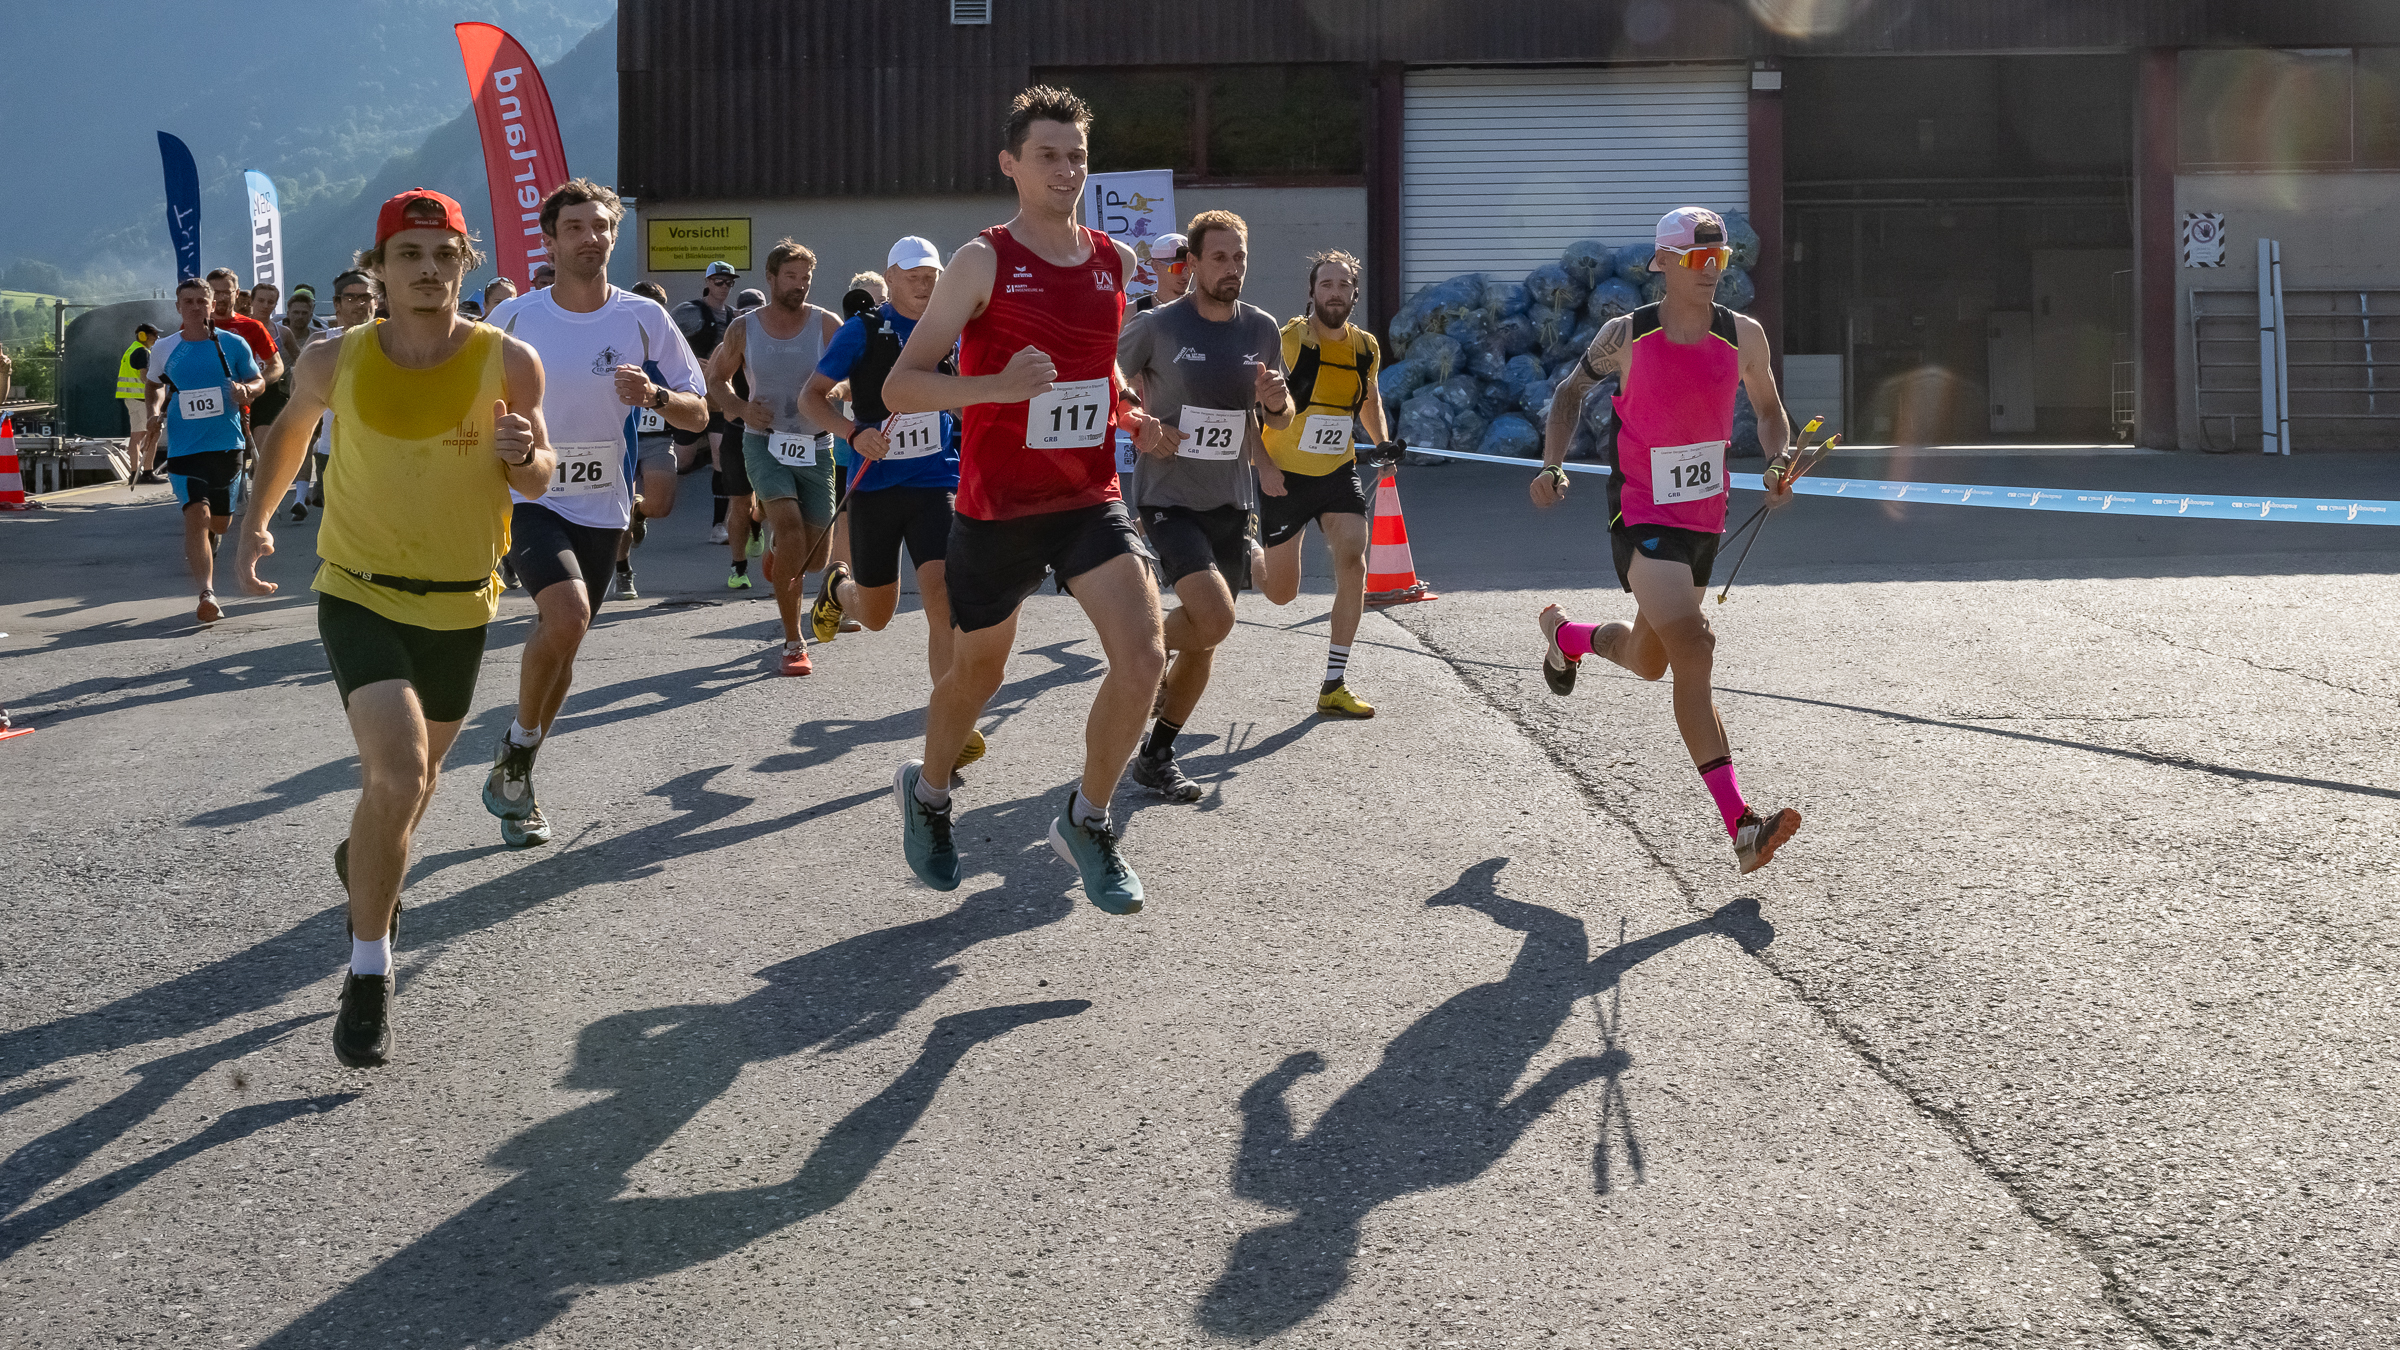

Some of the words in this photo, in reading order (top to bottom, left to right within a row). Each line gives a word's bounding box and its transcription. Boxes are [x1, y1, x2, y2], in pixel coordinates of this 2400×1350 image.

[1106, 190, 1129, 247] UP
[668, 226, 730, 238] Vorsicht!
[188, 398, 214, 412] 103
[642, 415, 657, 427] 19
[1050, 404, 1098, 431] 117
[42, 426, 52, 436] B
[896, 426, 929, 448] 111
[1195, 426, 1233, 448] 123
[1315, 428, 1342, 445] 122
[442, 439, 479, 456] mappo
[780, 442, 806, 459] 102
[555, 461, 603, 483] 126
[1670, 461, 1711, 489] 128
